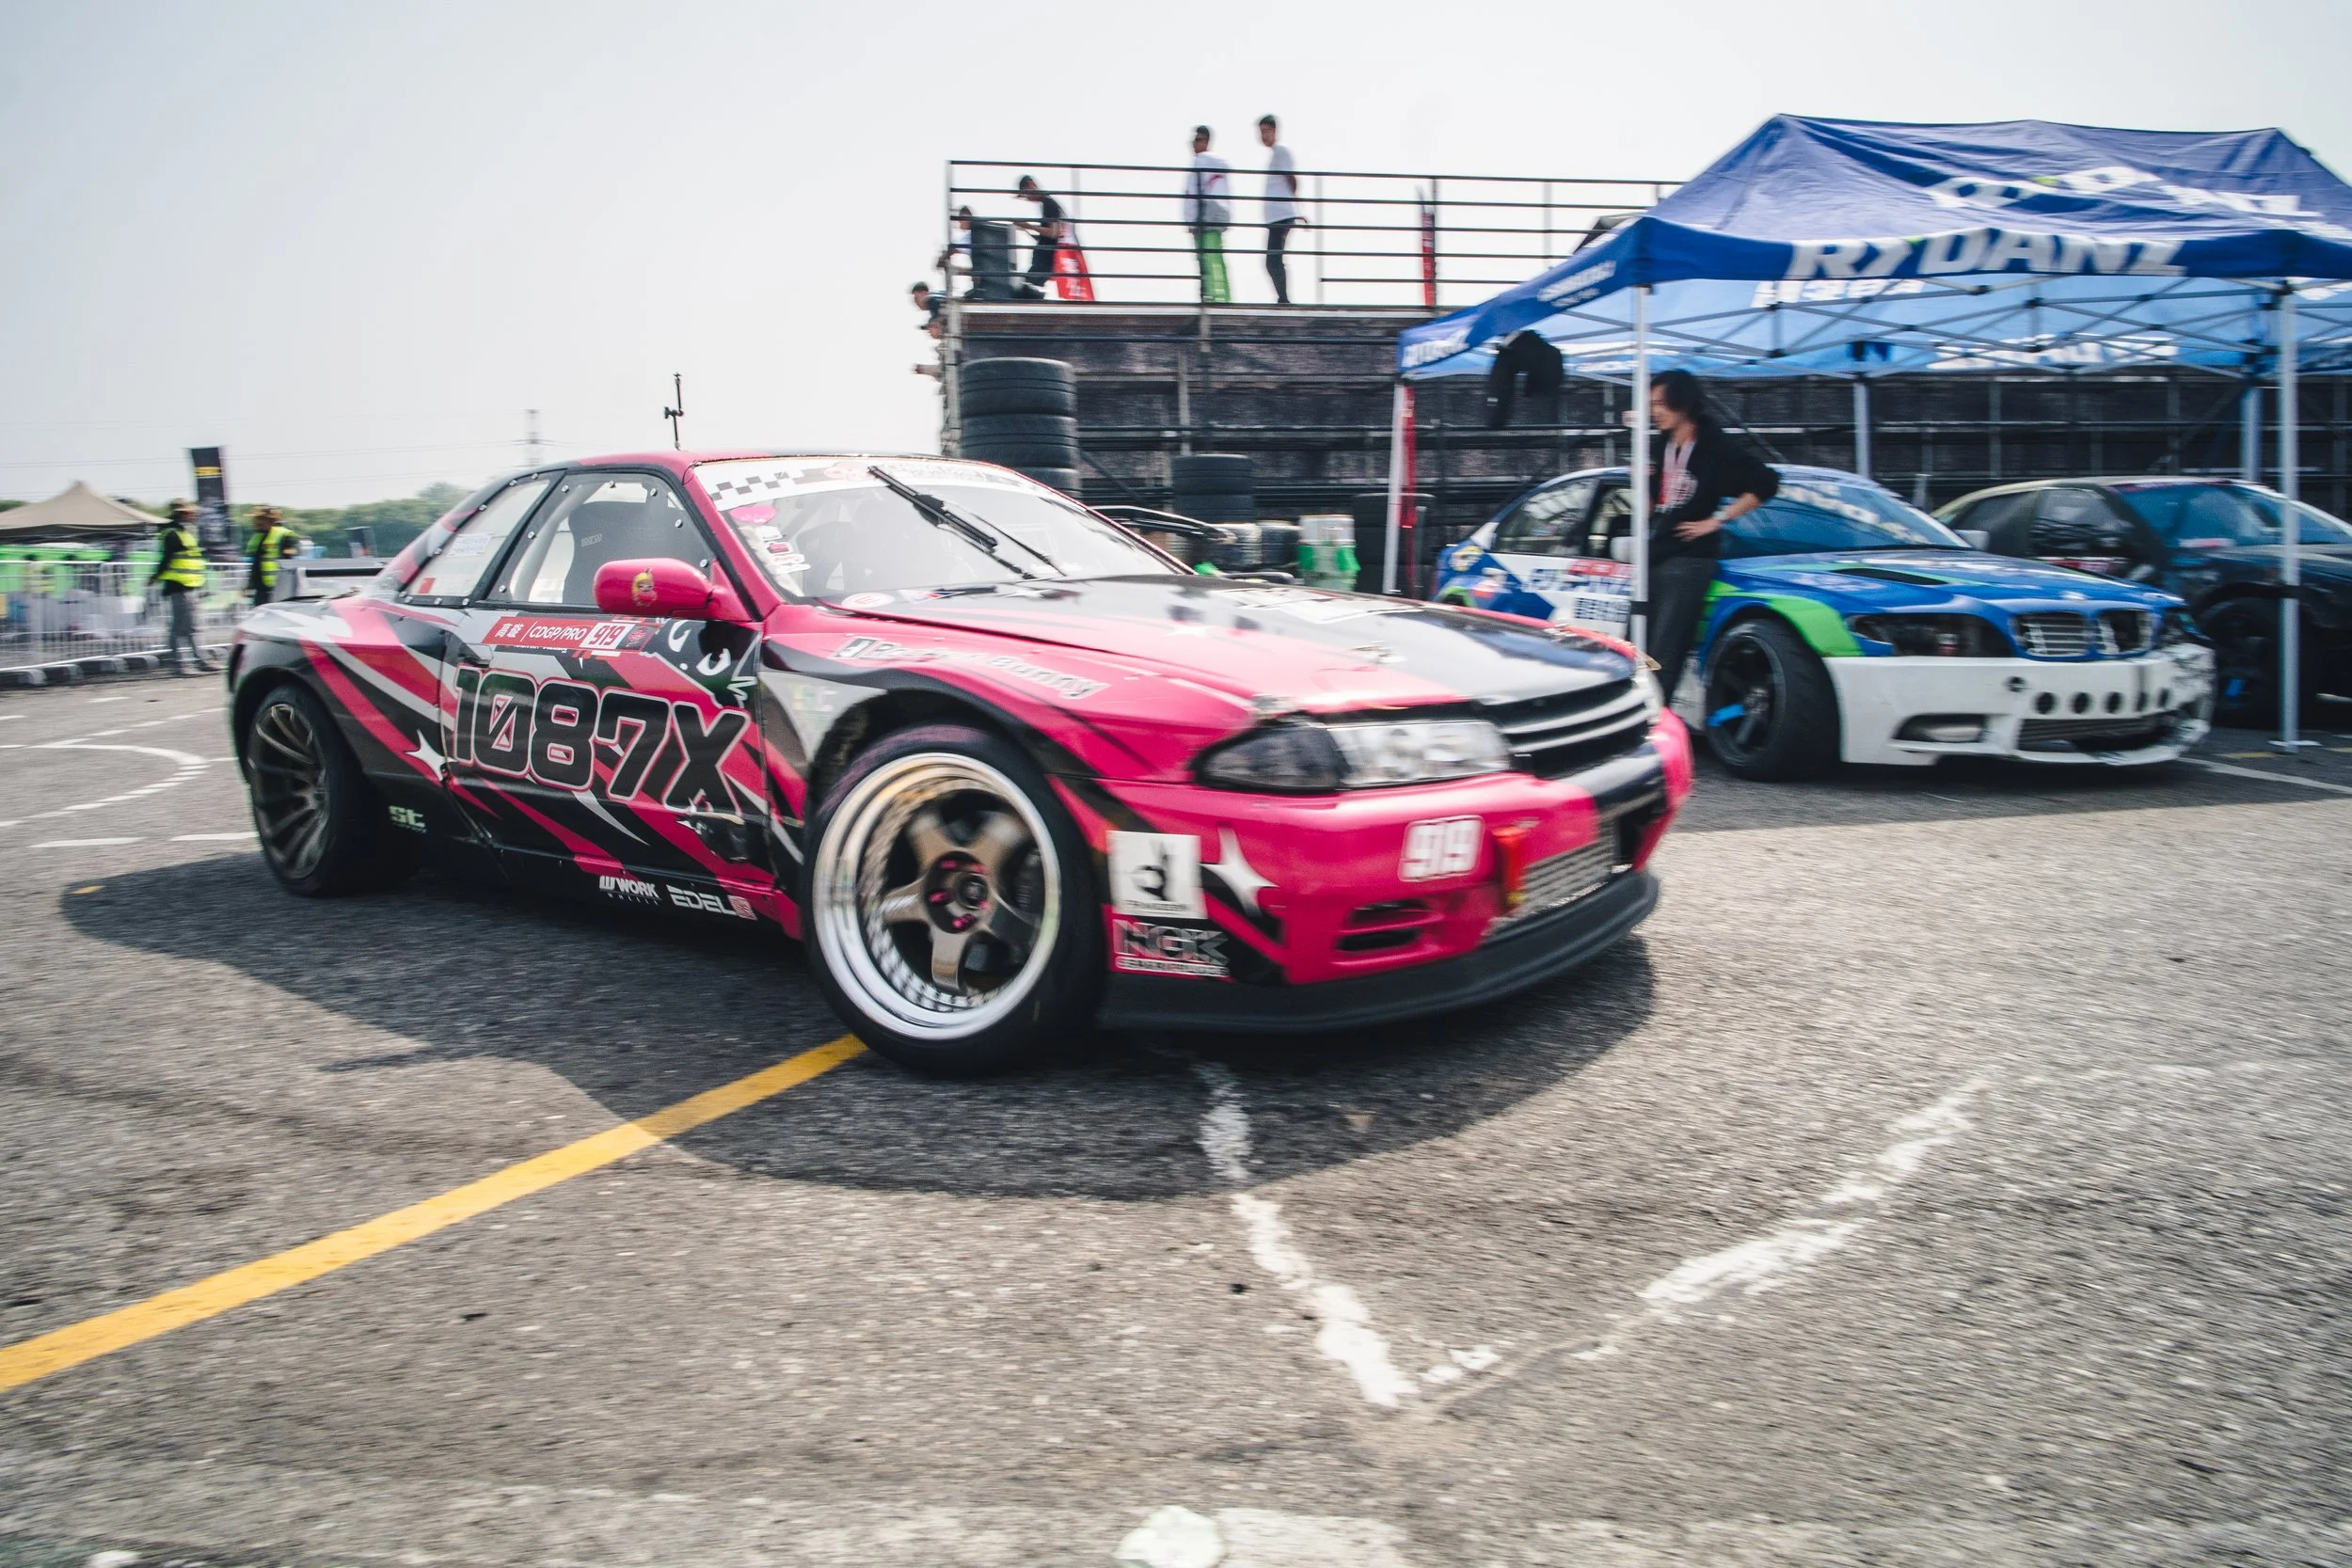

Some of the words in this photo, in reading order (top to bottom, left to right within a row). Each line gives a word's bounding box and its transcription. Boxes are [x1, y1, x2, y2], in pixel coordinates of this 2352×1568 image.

[1788, 228, 2186, 279] RYDANZ
[529, 625, 587, 641] CDGP/PRO
[588, 625, 626, 646] 919
[453, 663, 750, 822] 1087X
[615, 878, 660, 898] WORK
[666, 884, 737, 916] EDEL
[1112, 918, 1230, 966] NGK
